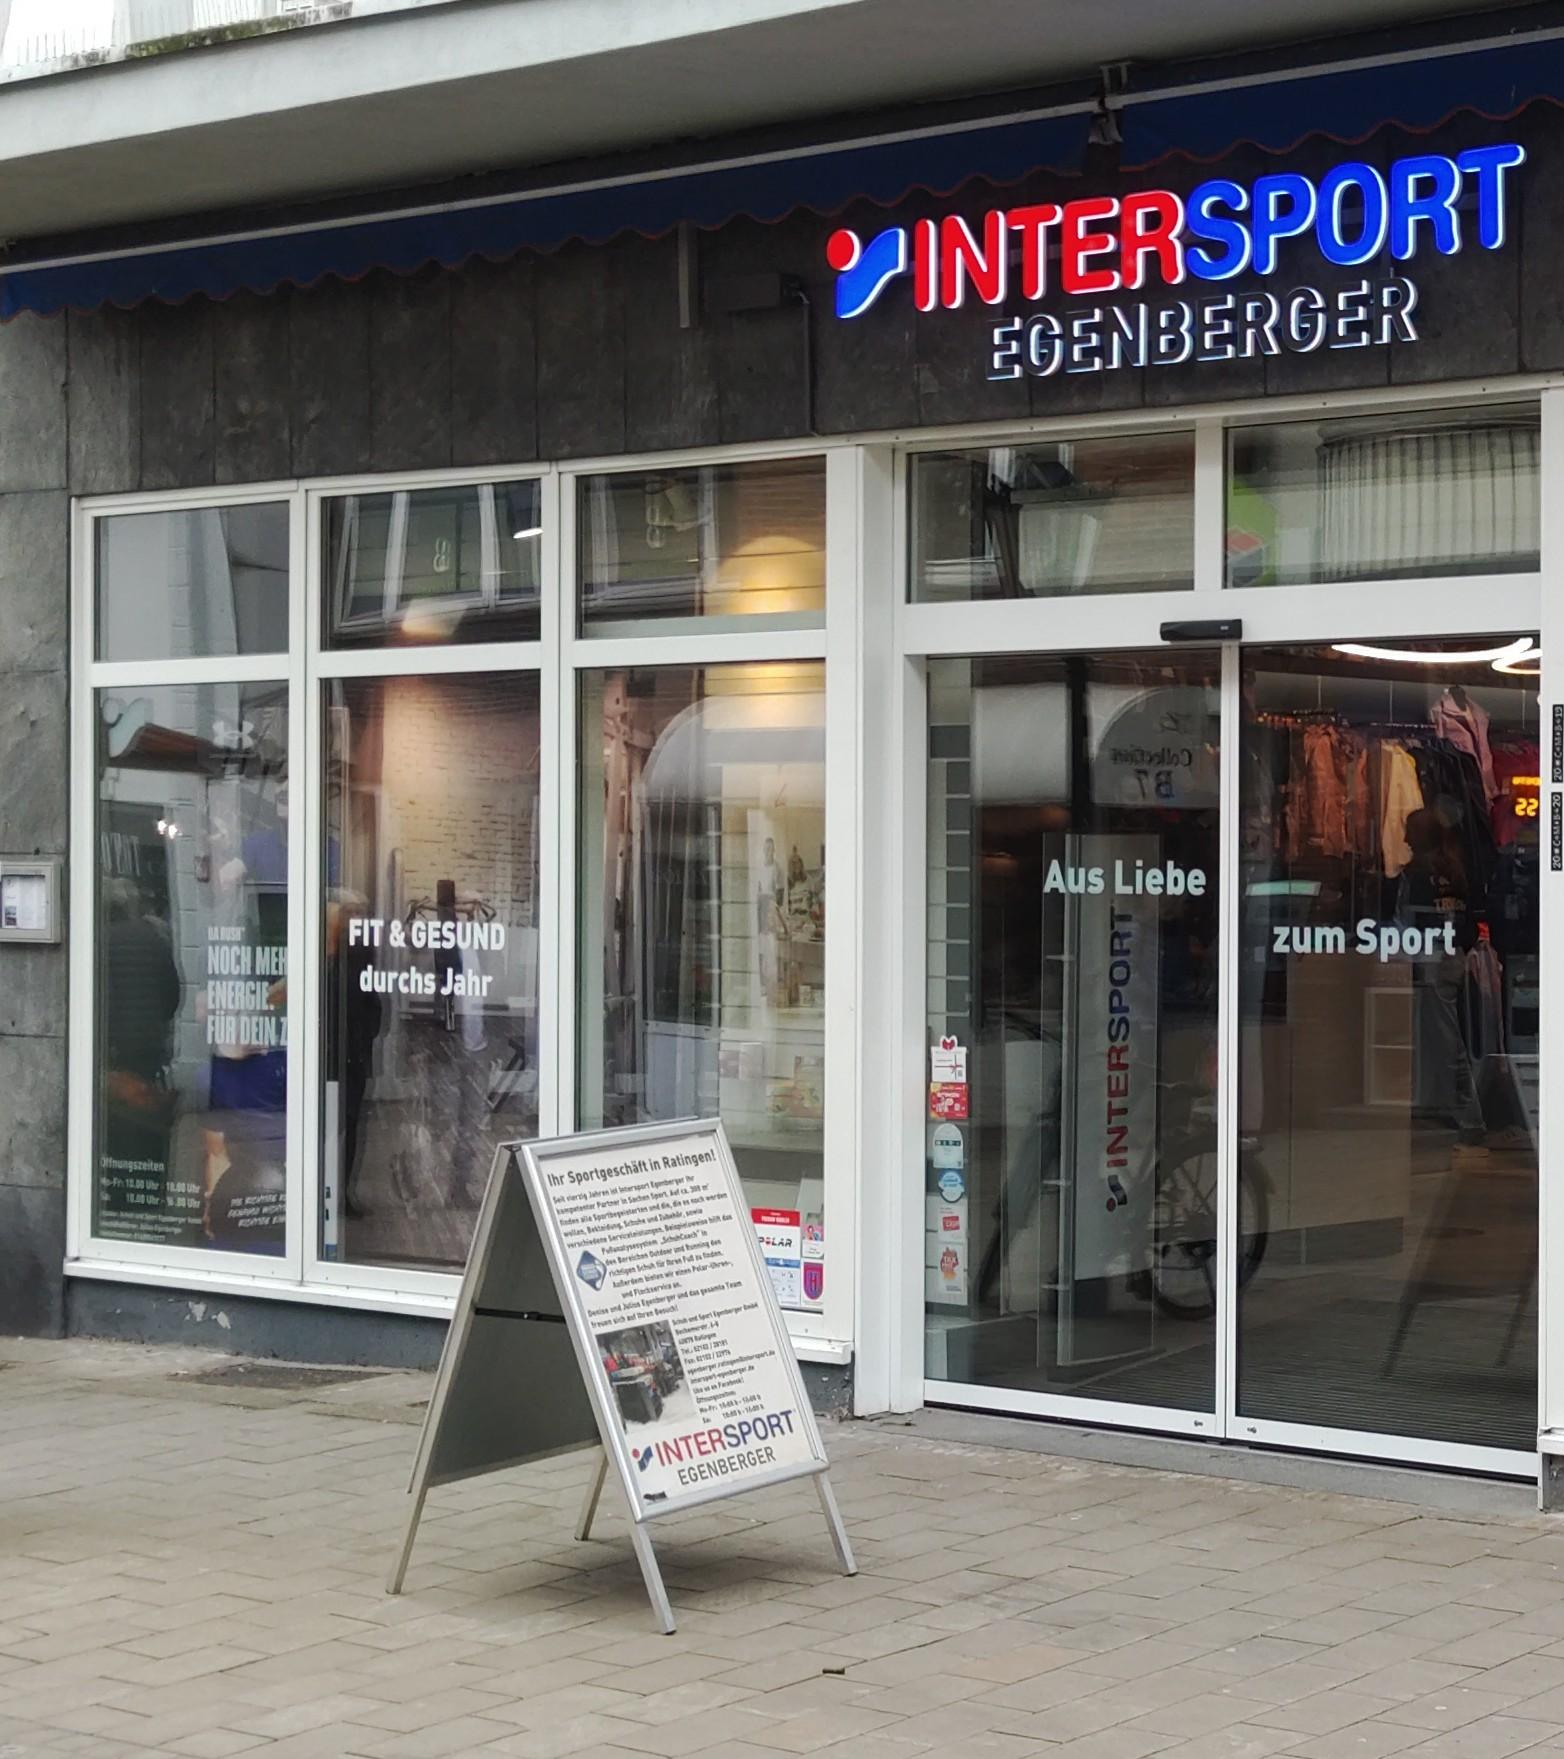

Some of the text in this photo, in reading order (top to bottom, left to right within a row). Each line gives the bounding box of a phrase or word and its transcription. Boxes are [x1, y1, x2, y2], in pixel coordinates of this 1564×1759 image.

[912, 143, 1526, 312] INTERSPORT
[986, 275, 1420, 381] EGENBERGER
[1043, 859, 1207, 896] Aus Liebe
[349, 918, 506, 951] FIT & GESUND
[1272, 918, 1457, 963] zum Sport
[207, 945, 288, 976] NOCH MEH
[360, 964, 494, 997] durchs Jahr
[206, 1010, 237, 1046] FÜR
[240, 1015, 276, 1046] DEIN
[1106, 904, 1133, 1168] INTERSPORT
[547, 1149, 716, 1187] Ihr Sportgeschäft in Ratingen!
[596, 1199, 620, 1209] Partner
[758, 1236, 793, 1248] POLAR
[655, 1409, 795, 1467] INTERSPORT
[677, 1445, 777, 1486] EGENBERGER
